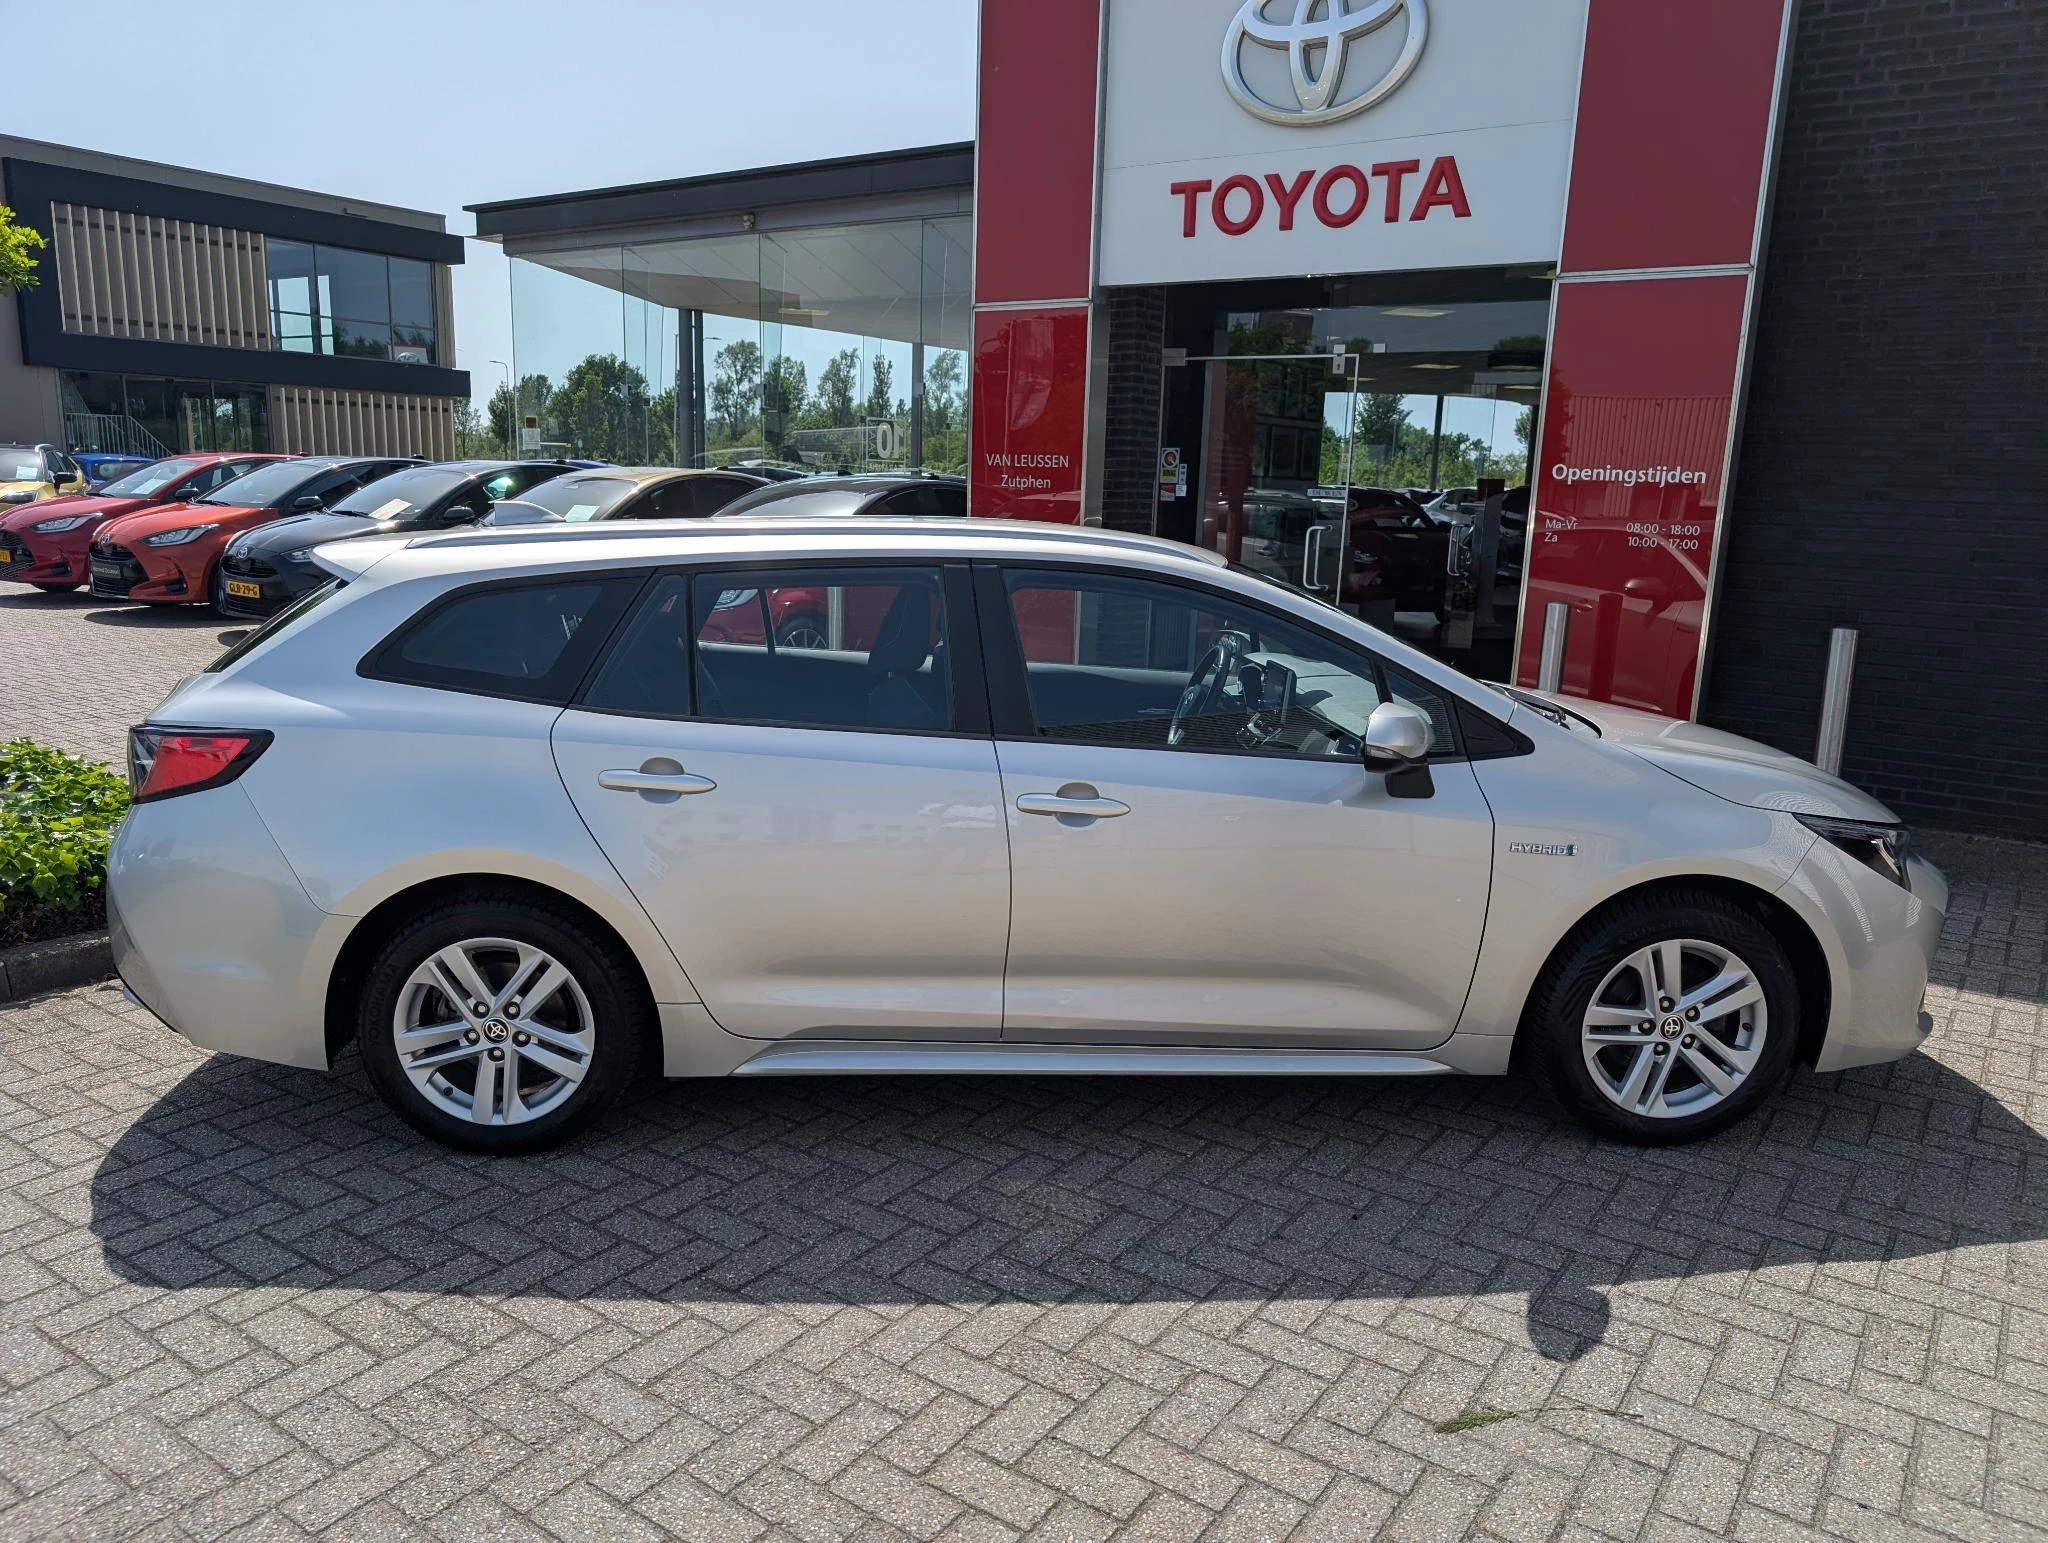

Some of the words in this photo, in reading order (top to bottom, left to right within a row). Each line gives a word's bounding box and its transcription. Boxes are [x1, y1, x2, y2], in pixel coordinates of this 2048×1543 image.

[1170, 155, 1472, 238] TOYOTA
[986, 453, 1012, 467] VAN
[1014, 454, 1069, 468] LEUSSEN
[1001, 474, 1051, 489] Zutphen
[1552, 464, 1707, 488] Openingstijden
[1545, 518, 1578, 529] Ma-Vr
[1626, 523, 1659, 534] 08:00
[1671, 525, 1700, 536] 18:00
[1544, 532, 1558, 542] Za
[1628, 537, 1658, 547] 10:00
[1669, 539, 1698, 550] 17:00
[1510, 842, 1567, 856] HYBRID
[368, 964, 400, 1046] YOKOHAMA
